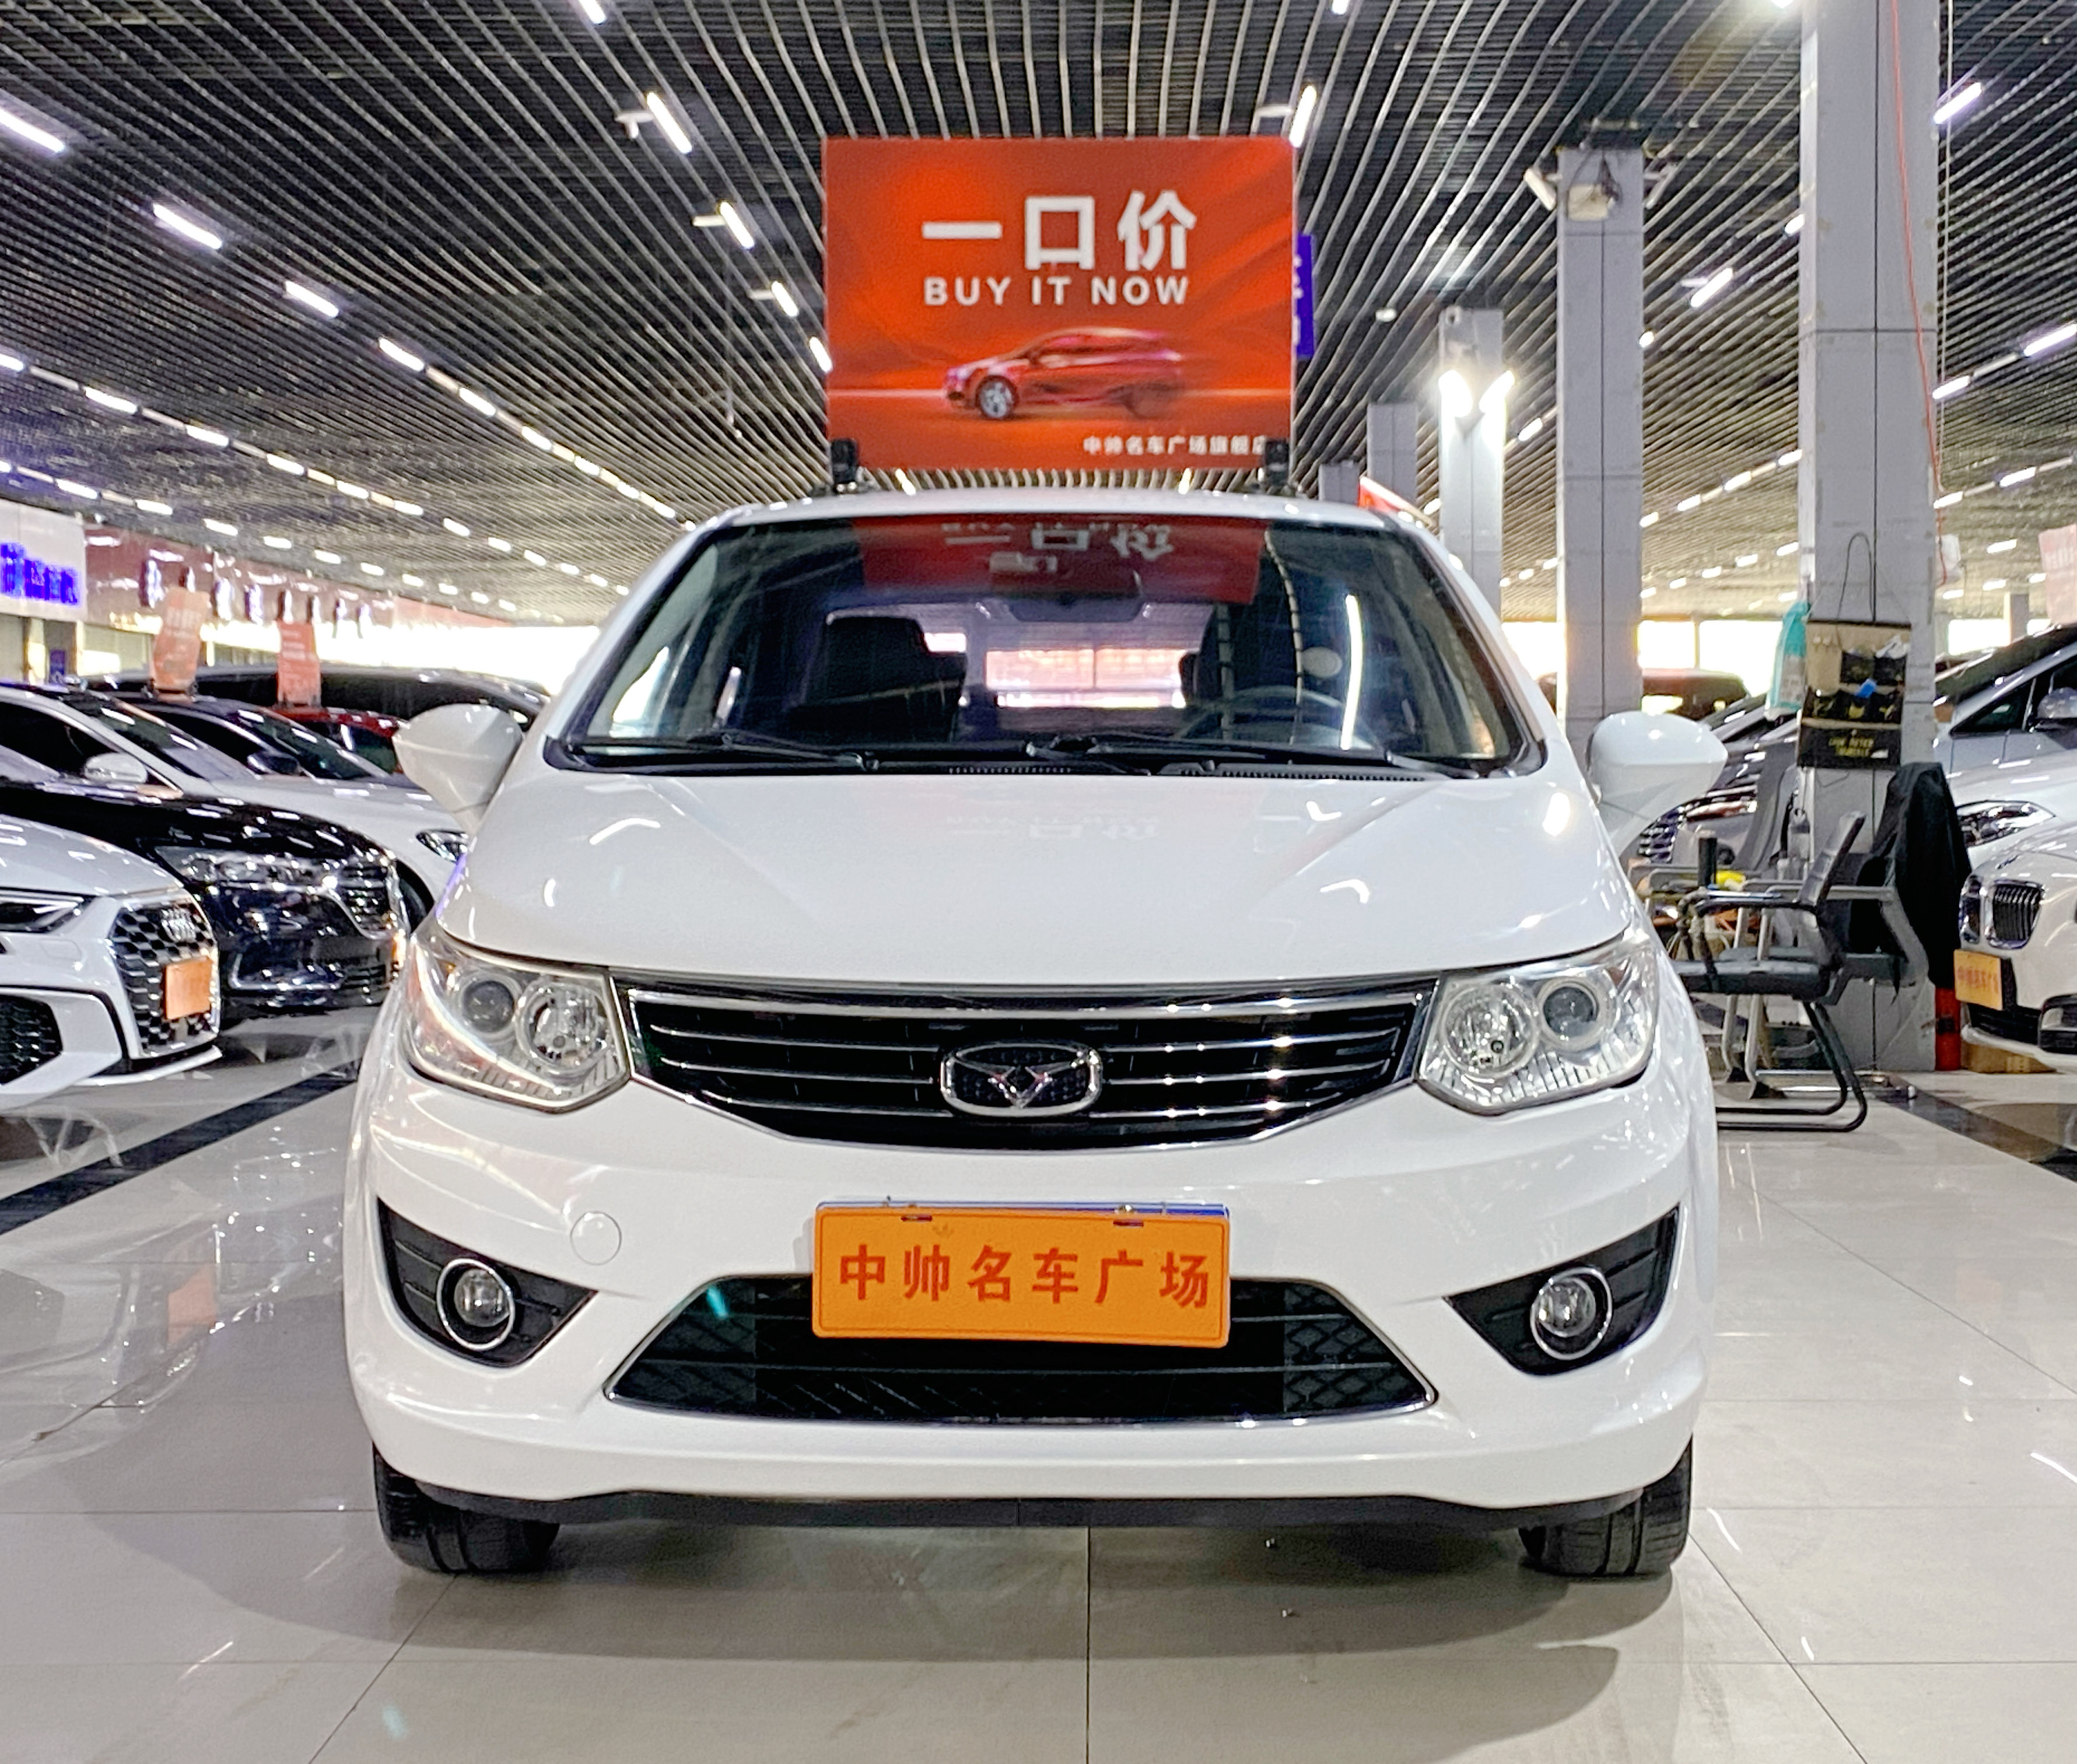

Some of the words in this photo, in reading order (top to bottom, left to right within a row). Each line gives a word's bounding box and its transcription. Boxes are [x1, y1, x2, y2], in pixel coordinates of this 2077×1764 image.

[922, 190, 1197, 271] 一口价
[924, 276, 1012, 306] BUY
[1031, 276, 1071, 306] IT
[1091, 276, 1188, 306] NOW
[839, 1244, 1210, 1308] 中帅名车广场
